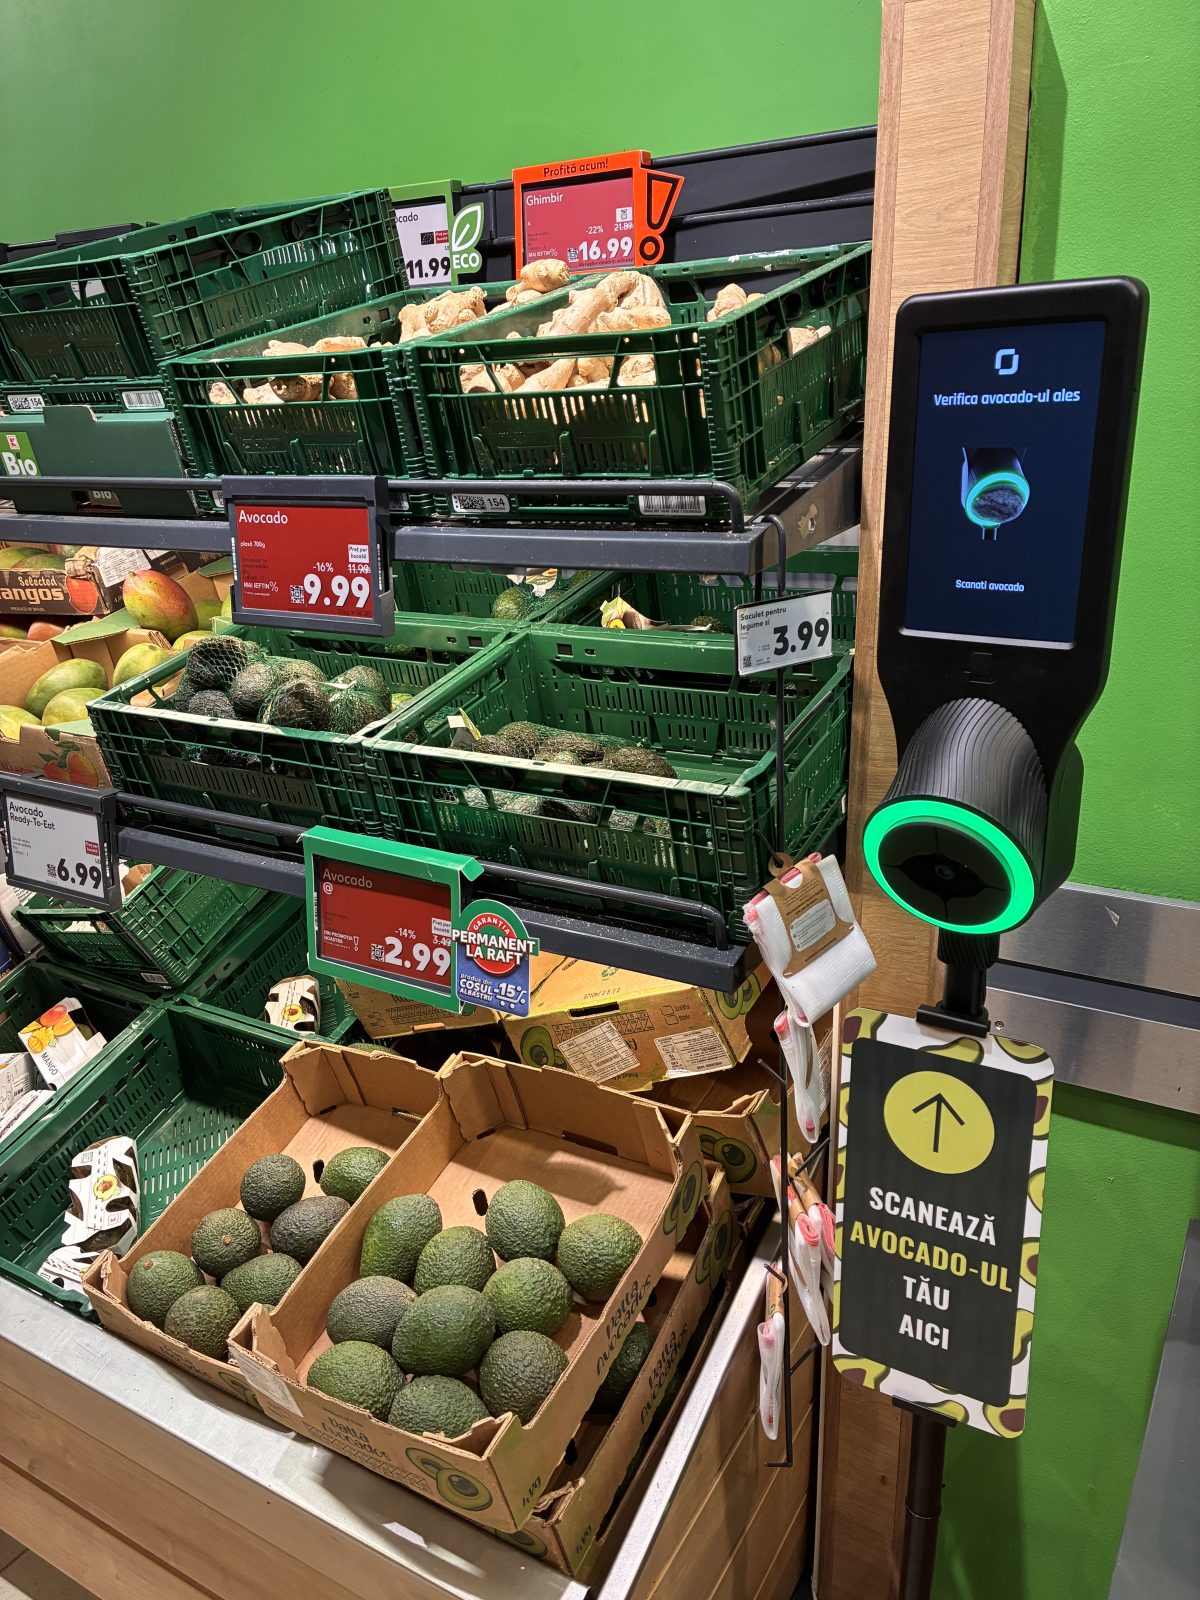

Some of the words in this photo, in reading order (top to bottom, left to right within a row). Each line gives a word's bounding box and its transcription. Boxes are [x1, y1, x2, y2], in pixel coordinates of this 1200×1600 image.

[543, 164, 577, 178] Profită
[579, 157, 609, 172] acum!
[526, 192, 564, 206] Ghimbir
[395, 211, 419, 223] ocado
[585, 225, 604, 235] -22%
[579, 236, 633, 261] 16.99
[406, 256, 451, 279] 11.99
[452, 252, 480, 269] ECO
[934, 392, 979, 406] Verifica
[981, 389, 1050, 405] avocado-ul
[1052, 388, 1081, 403] ales
[1, 451, 38, 476] Bio
[486, 497, 505, 506] 154
[238, 509, 289, 524] Avocado
[312, 562, 334, 573] -16%
[18, 575, 58, 588] Selected
[303, 573, 370, 608] 9.99
[955, 579, 988, 590] Scanati
[988, 582, 1025, 592] avocado
[0, 587, 65, 605] angos
[740, 610, 764, 621] Saculet
[765, 607, 787, 618] pentru
[740, 620, 764, 631] legume
[764, 618, 770, 626] si
[773, 617, 830, 656] 3.99
[9, 801, 44, 818] Avocado
[9, 812, 55, 831] Ready-To-Eat
[57, 858, 102, 890] 6.99
[322, 867, 373, 889] Avocado
[394, 927, 417, 940] -14%
[452, 929, 536, 953] PERMANENT
[384, 936, 451, 977] 2.99
[466, 944, 484, 959] LA
[486, 949, 523, 965] RAFT
[459, 973, 482, 983] produs
[459, 988, 493, 1002] ALBASTRU
[41, 1051, 59, 1076] MANGO
[868, 1185, 998, 1247] SCANEAZĂ
[849, 1220, 1014, 1293] AVOCADO-UL
[902, 1275, 951, 1311] TĂU
[898, 1314, 951, 1351] AICI
